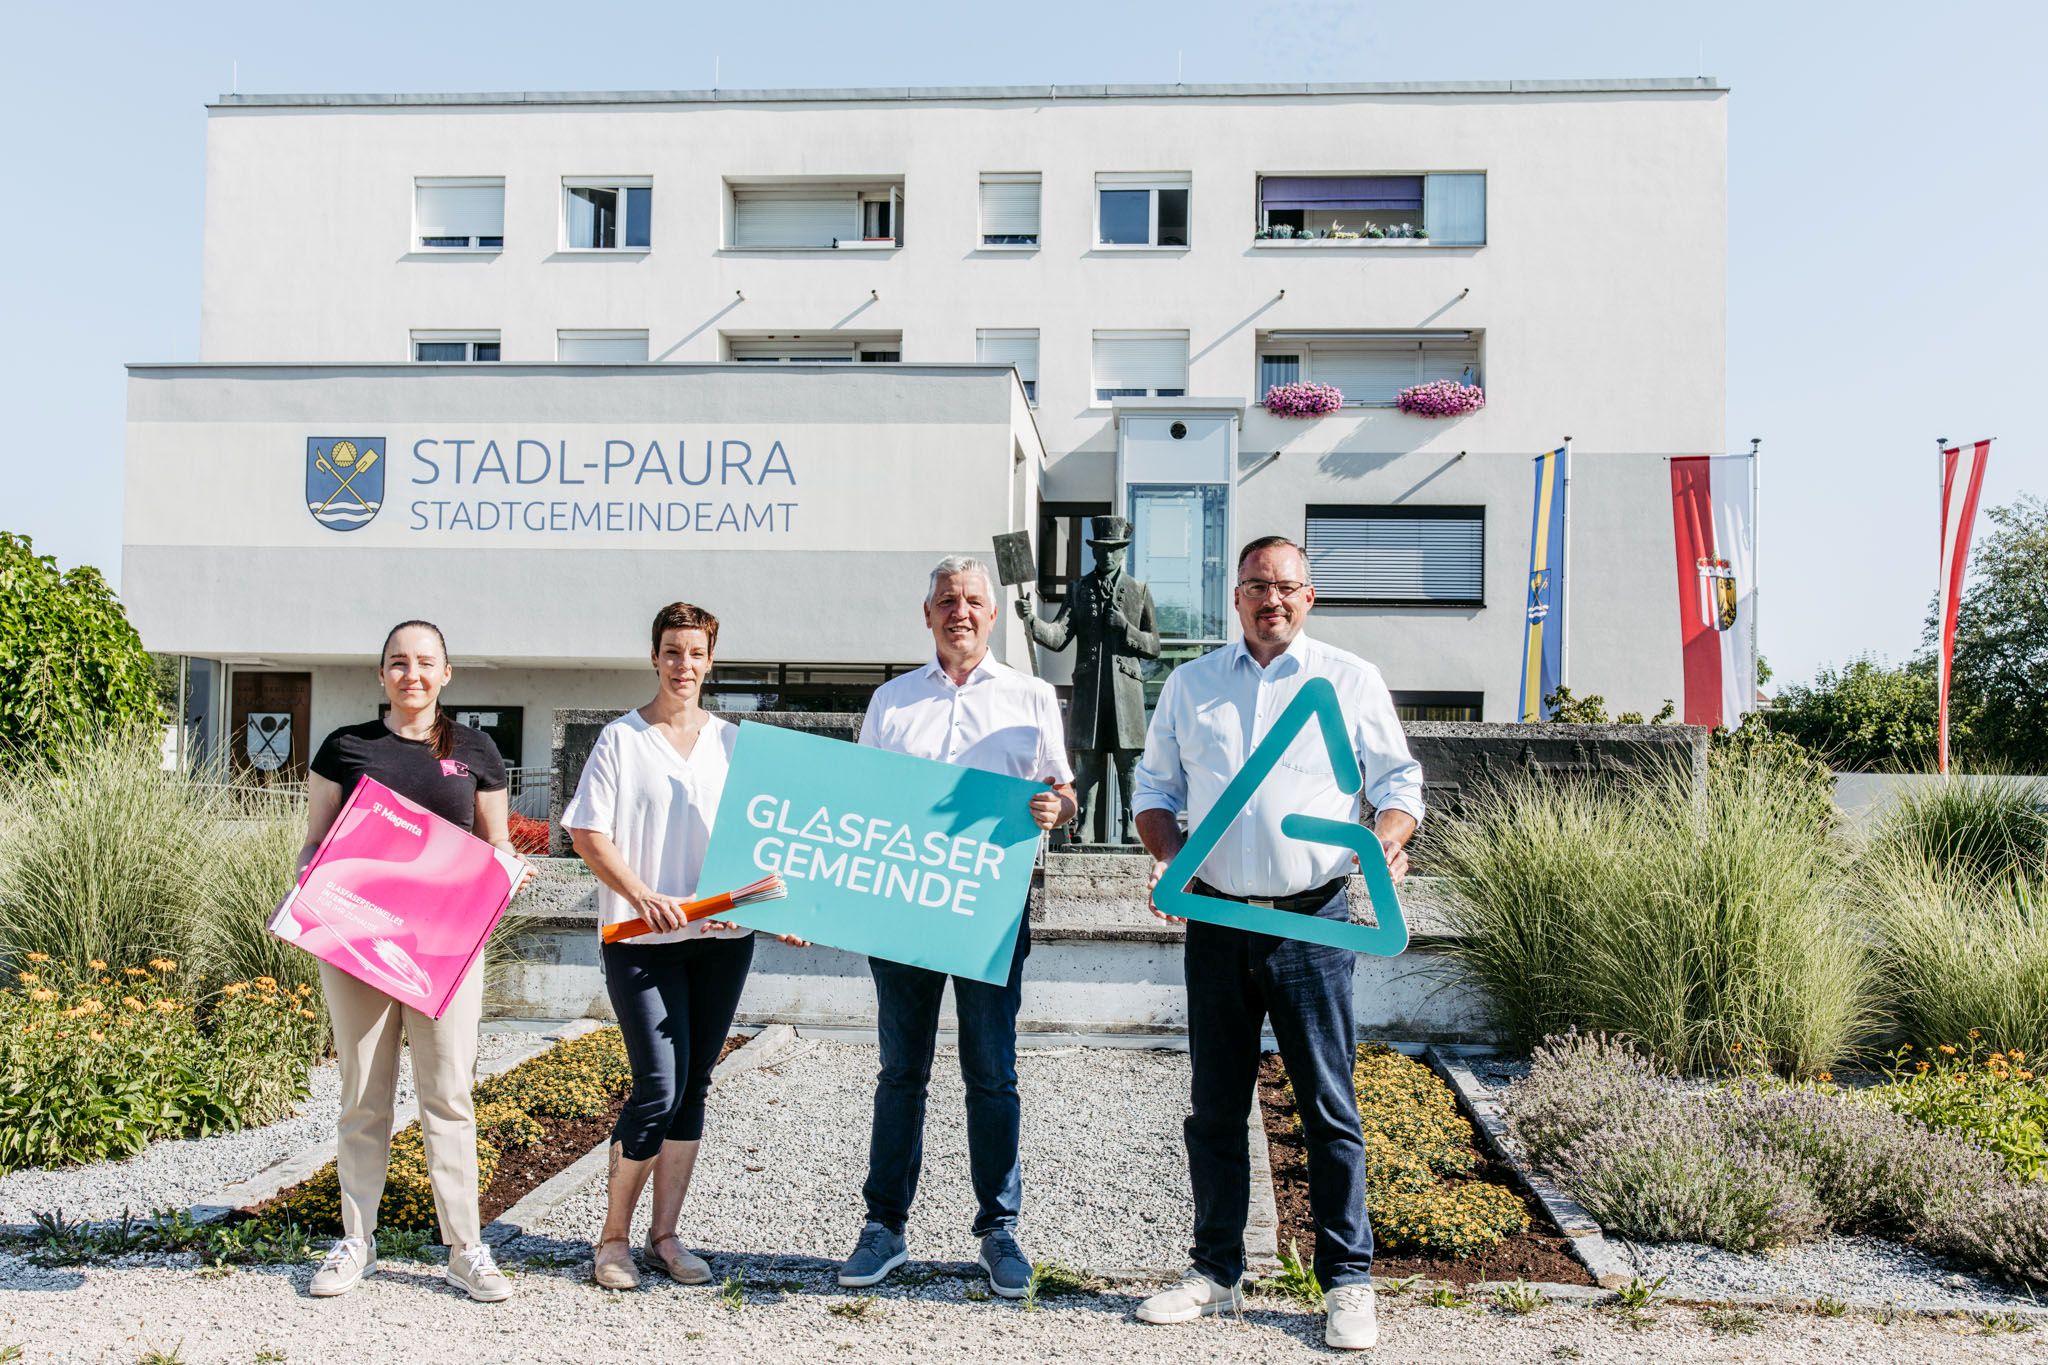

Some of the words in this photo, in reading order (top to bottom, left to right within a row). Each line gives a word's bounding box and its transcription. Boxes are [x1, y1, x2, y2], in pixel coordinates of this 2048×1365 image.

[411, 439, 797, 486] STADL-PAURA
[410, 500, 798, 532] STADTGEMEINDEAMT
[380, 807, 423, 837] Magenta
[747, 794, 1005, 880] GLASFASER
[753, 836, 981, 917] GEMEINDE
